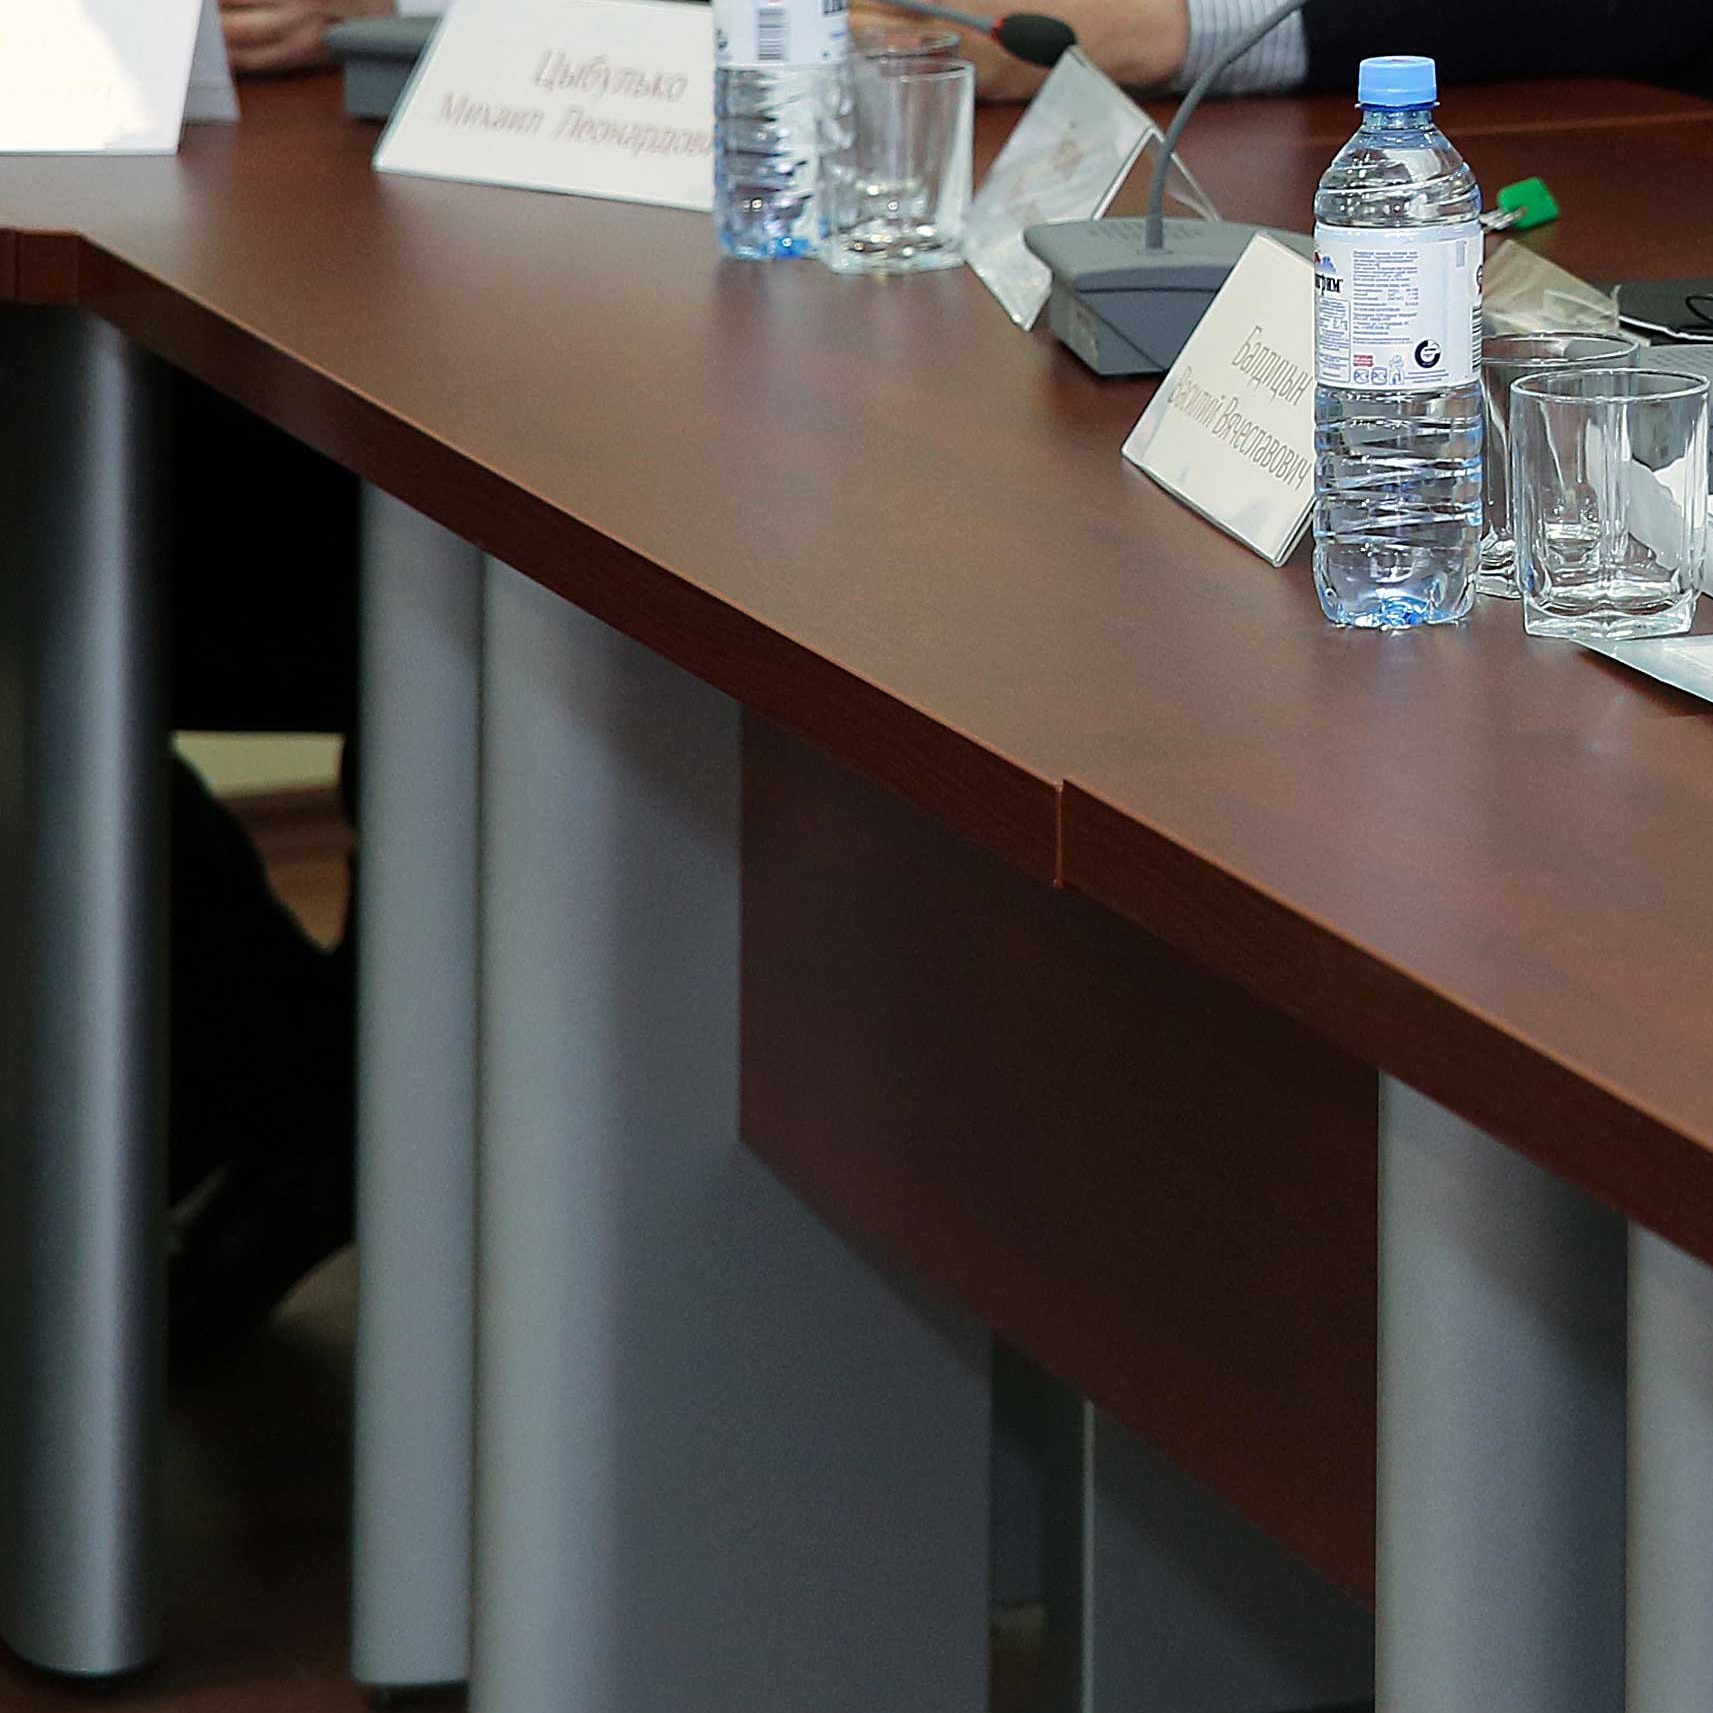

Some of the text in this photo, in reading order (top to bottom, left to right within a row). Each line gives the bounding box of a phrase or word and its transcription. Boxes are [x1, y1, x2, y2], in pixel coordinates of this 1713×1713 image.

[533, 48, 688, 102] Цыбулько
[438, 91, 543, 134] Михаил
[1232, 325, 1313, 406] Балдицын
[1212, 397, 1312, 491] Вячеславович
